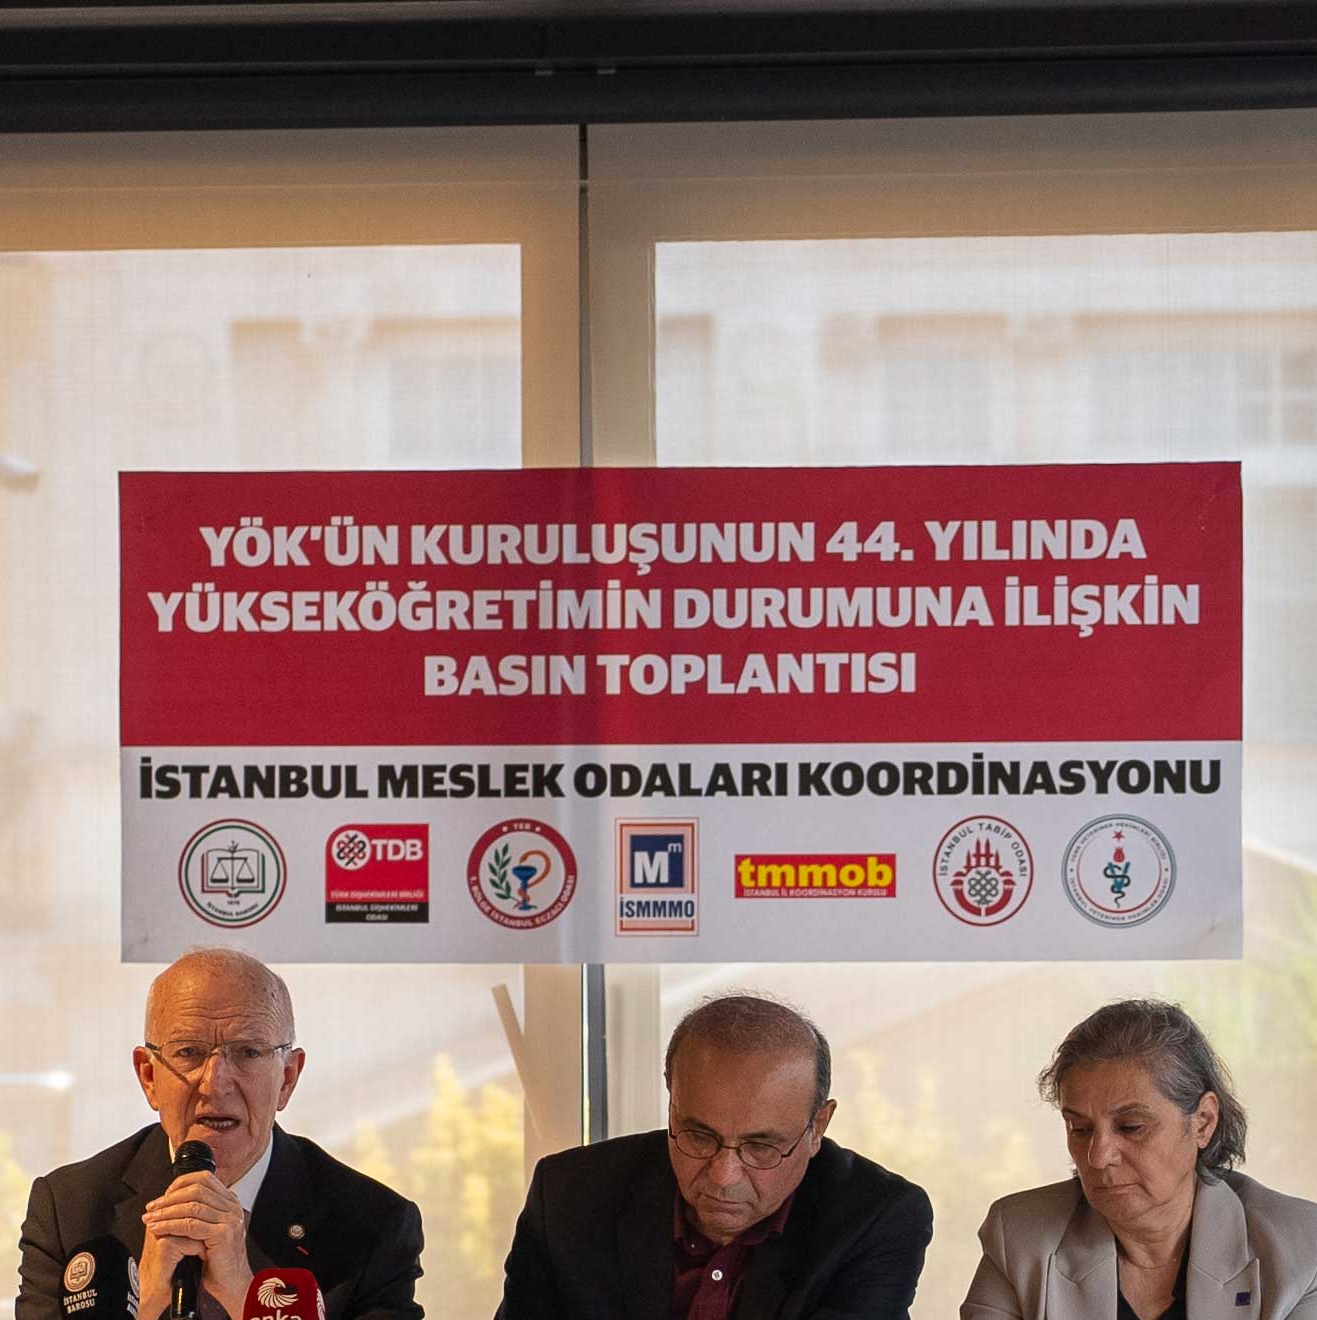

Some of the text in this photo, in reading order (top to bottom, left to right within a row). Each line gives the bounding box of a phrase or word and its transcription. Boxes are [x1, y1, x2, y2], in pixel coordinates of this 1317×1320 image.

[199, 515, 1147, 576] YÖK'ÜN KURULUŞUNUN 44. YILINDA
[147, 574, 1200, 638] YÜKSEKÖĞRETİMİN DURUMUNA İLİŞKİN
[423, 652, 916, 696] BASIN TOPLANTISI
[139, 751, 1222, 800] İSTANBUL MESLEK ODALARI KOORDİNASYONU
[369, 839, 424, 861] TDB
[737, 856, 894, 888] tmmob
[1011, 841, 1028, 877] ODASI
